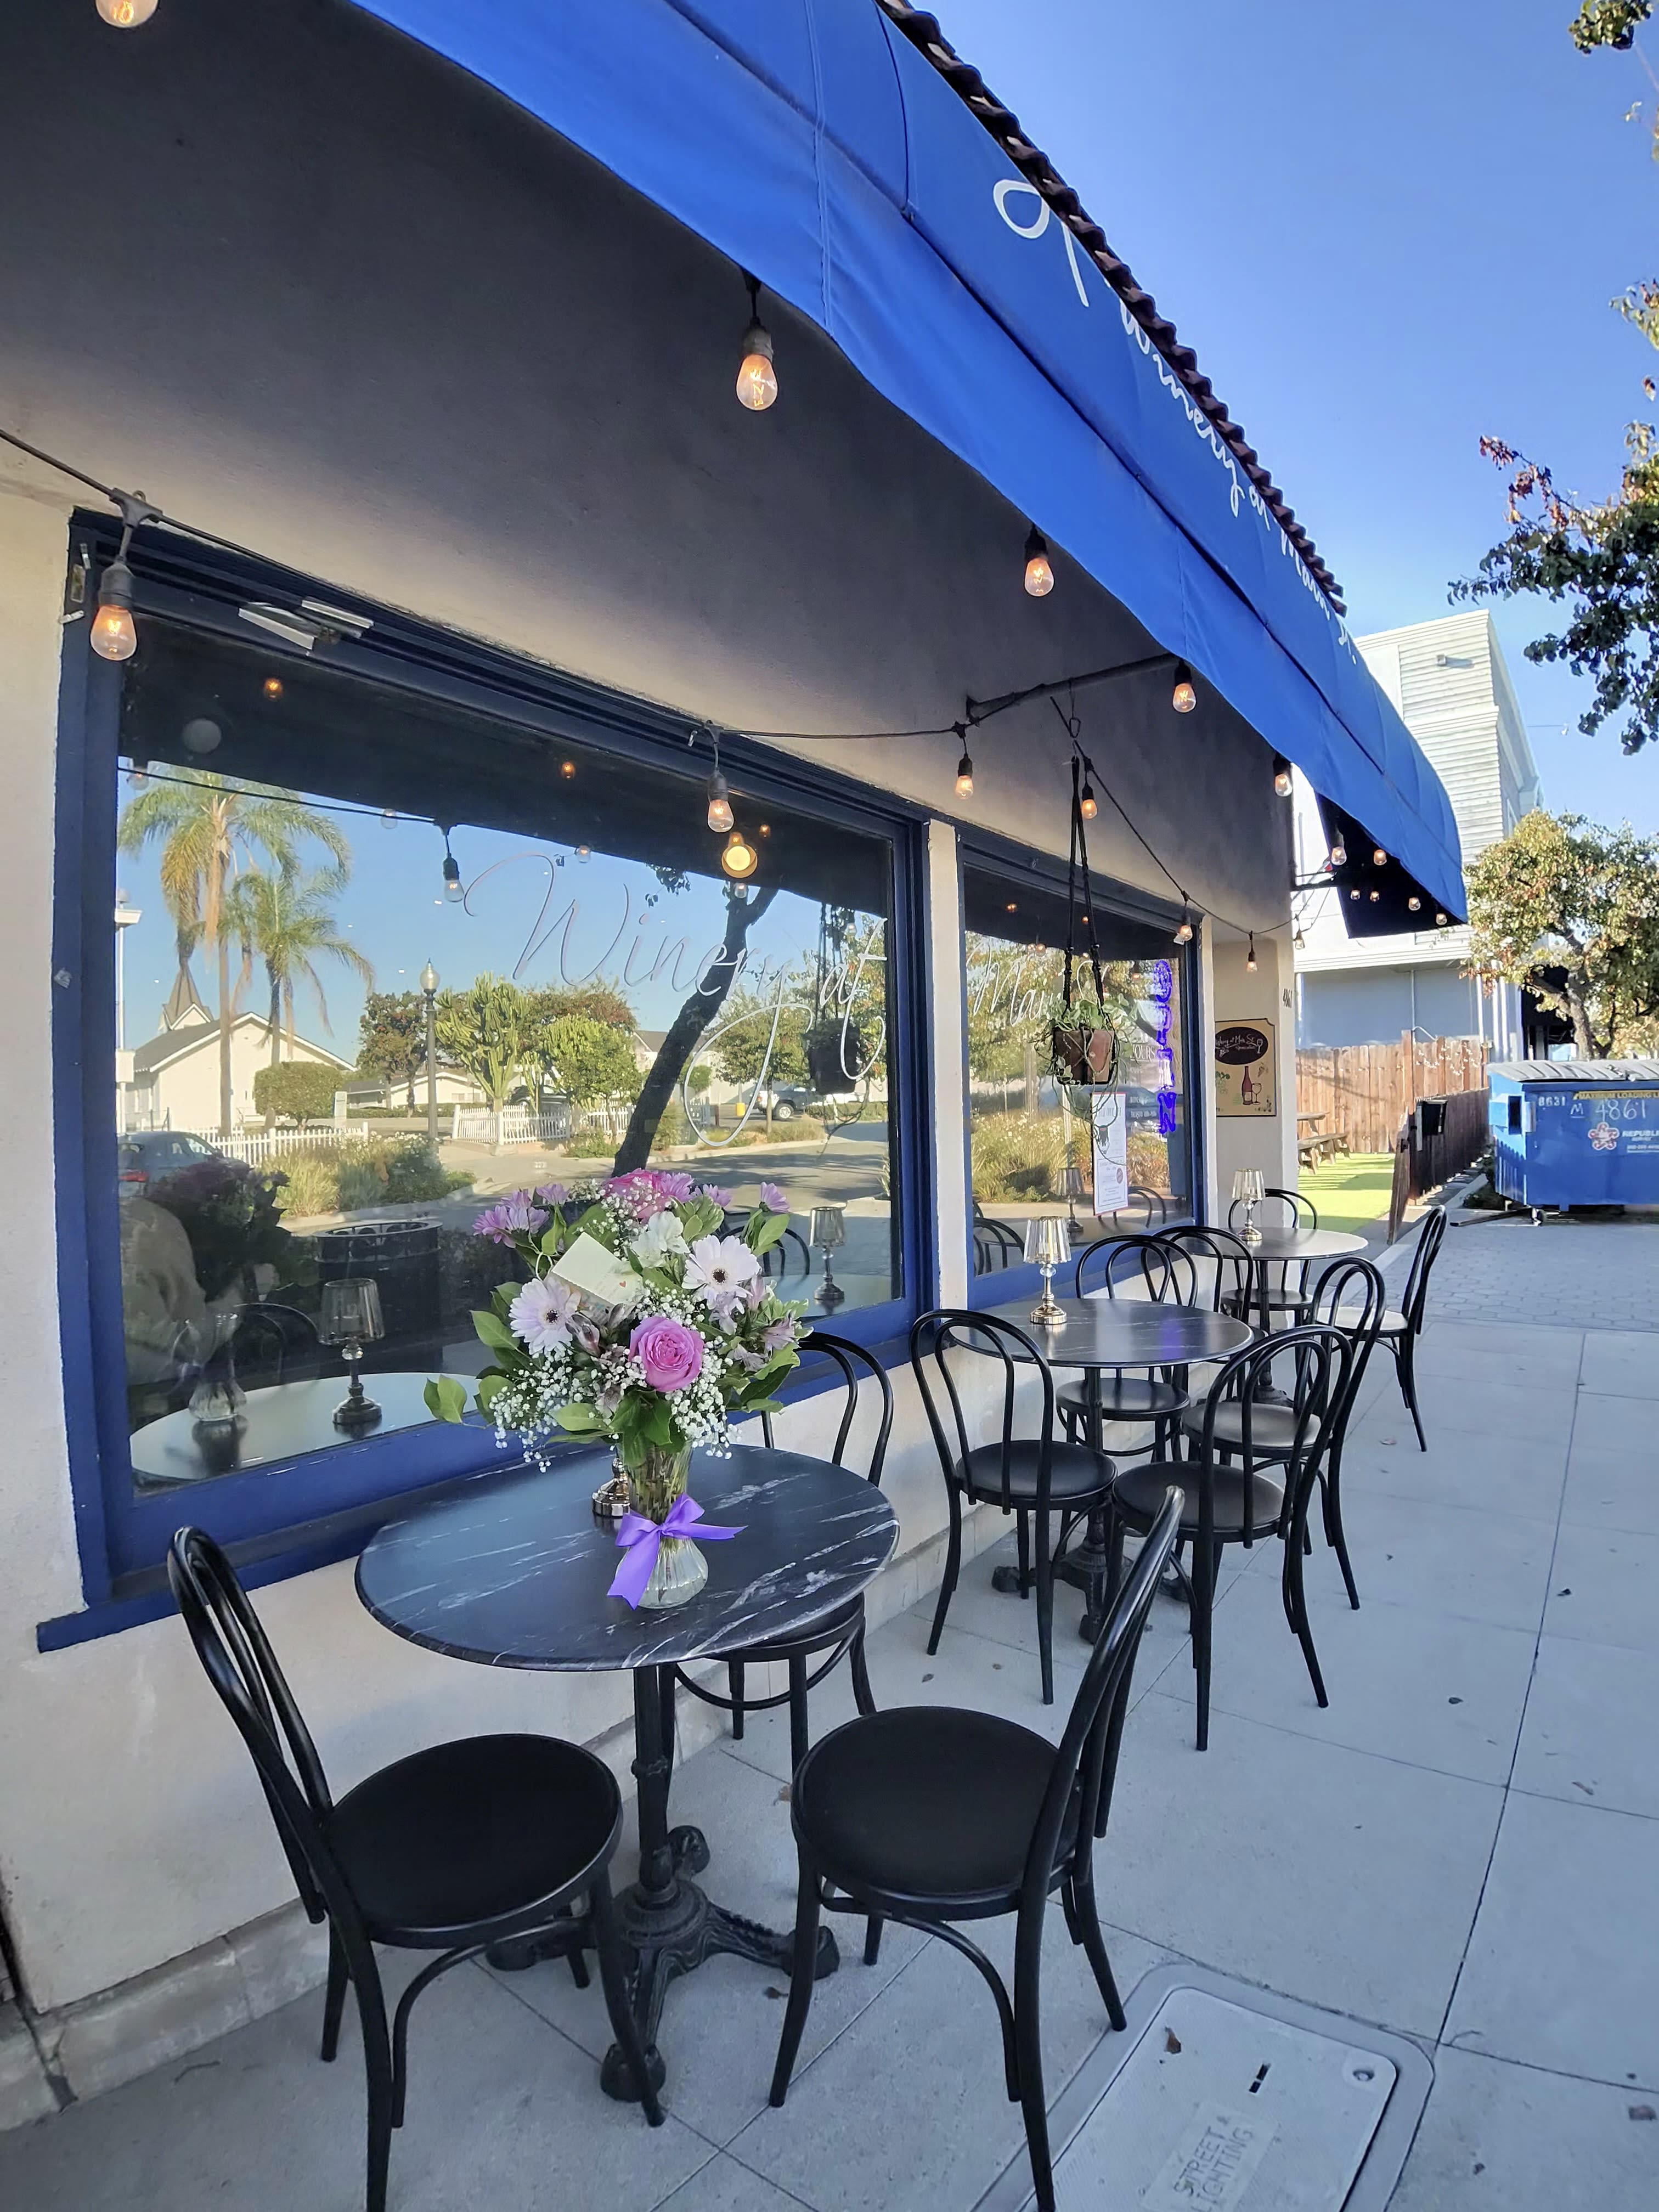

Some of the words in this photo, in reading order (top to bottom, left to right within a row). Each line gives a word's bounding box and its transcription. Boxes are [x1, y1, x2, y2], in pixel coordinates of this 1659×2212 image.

[463, 852, 813, 1147] Winery
[819, 917, 888, 1081] at
[1538, 1096, 1566, 1106] 8631
[1595, 1099, 1646, 1121] 4861
[1174, 2125, 1226, 2196] STREET
